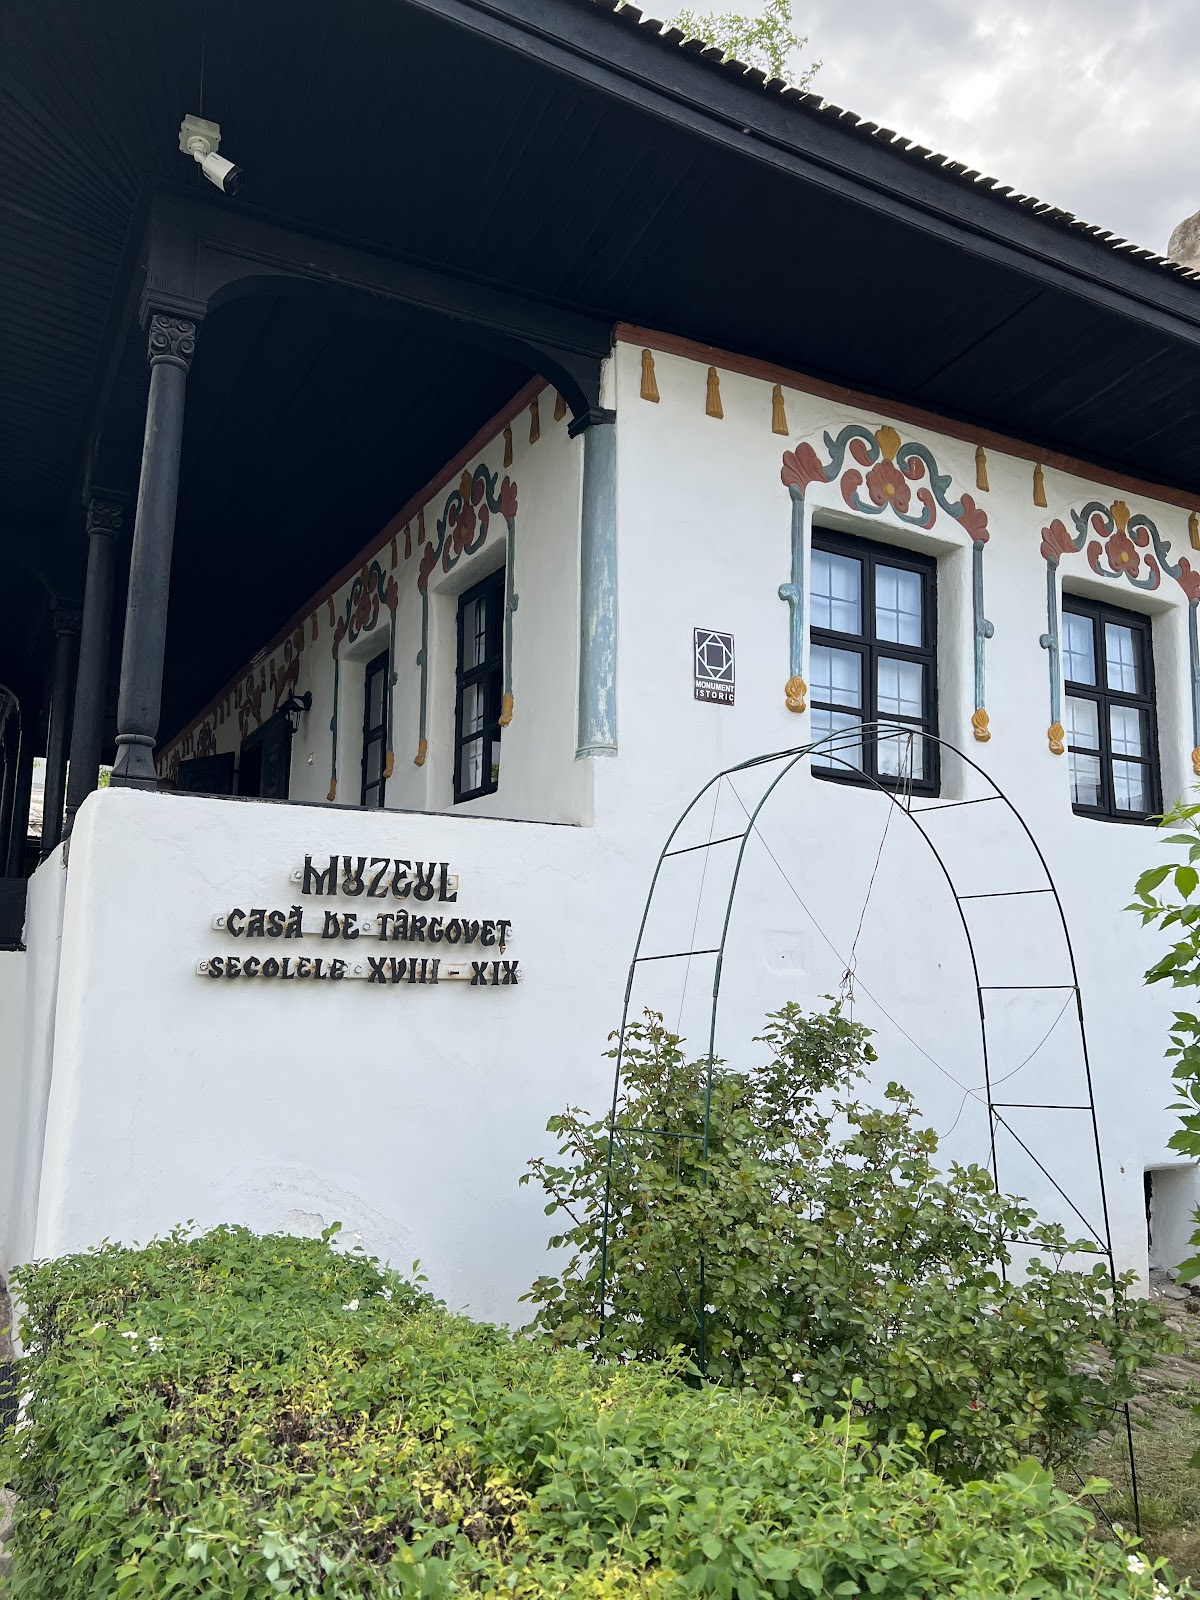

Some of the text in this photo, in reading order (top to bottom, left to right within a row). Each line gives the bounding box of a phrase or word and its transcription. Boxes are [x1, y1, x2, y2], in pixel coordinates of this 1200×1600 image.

[695, 680, 735, 693] MONUMENT
[695, 689, 734, 701] ISTORIC
[301, 853, 458, 903] MUZEUL
[226, 905, 304, 939] CASĂ
[322, 910, 360, 940] DE
[208, 956, 349, 980] SECOLELE
[367, 957, 440, 985] XVIII
[470, 960, 519, 986] XIX
